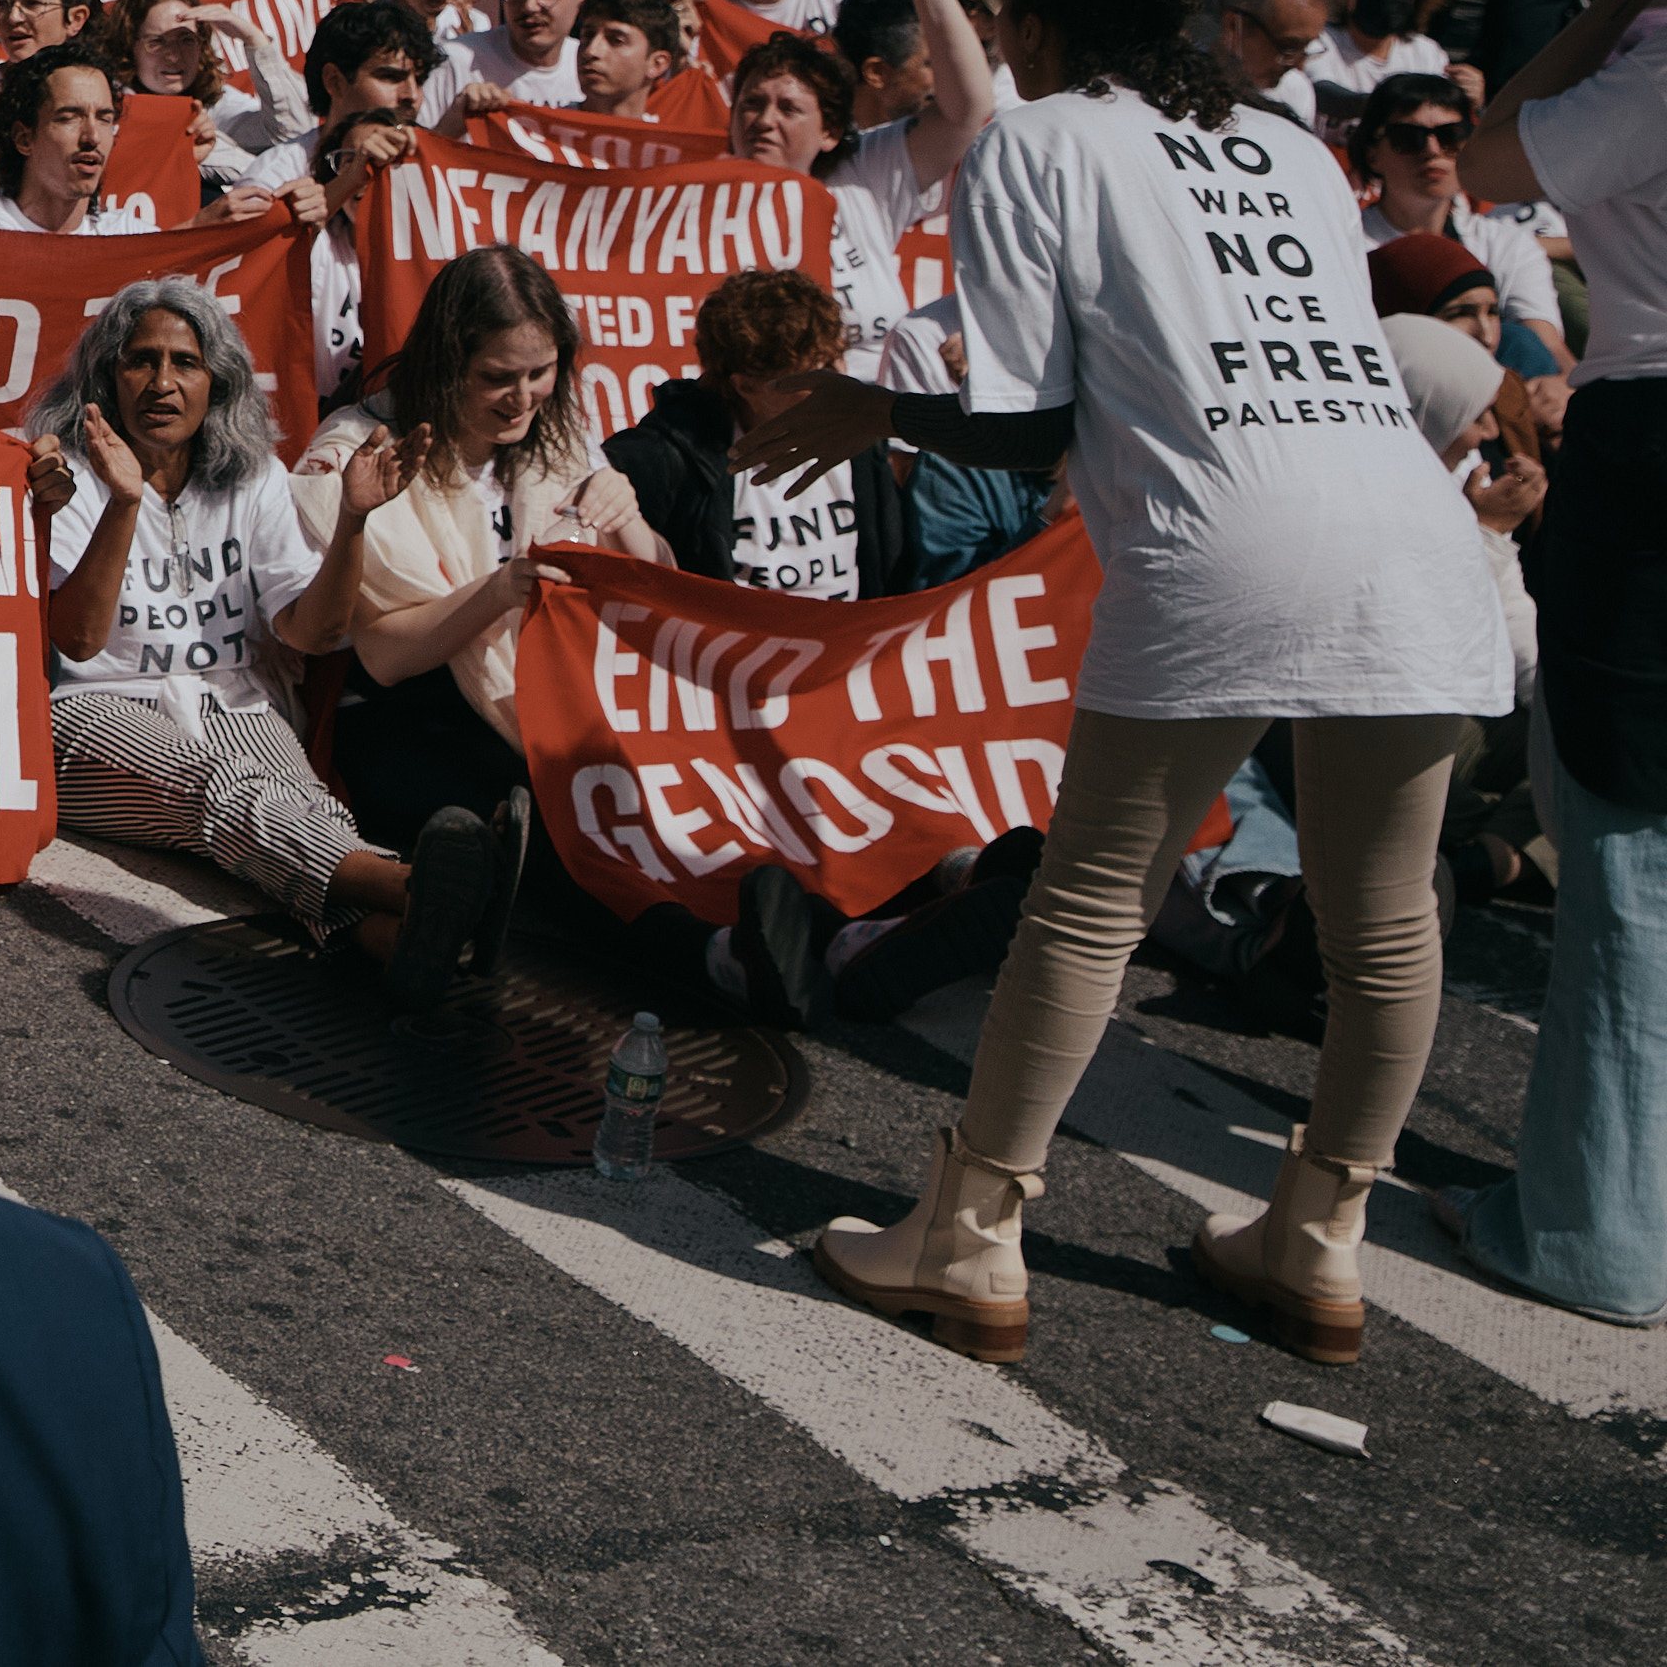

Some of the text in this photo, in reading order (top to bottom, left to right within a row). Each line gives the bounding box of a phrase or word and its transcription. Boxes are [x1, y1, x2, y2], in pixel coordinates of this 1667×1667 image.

[1153, 131, 1273, 176] NO
[389, 161, 804, 275] NETANYAHU
[1188, 187, 1295, 220] WAR
[1204, 231, 1315, 278] NO
[560, 293, 653, 347] TED
[1244, 293, 1327, 324] ICE
[1209, 339, 1391, 387] FREE
[1203, 398, 1412, 433] PALESTIN
[733, 553, 848, 589] EOPL
[119, 593, 244, 631] PEOPL
[138, 629, 246, 674] NOT
[593, 572, 1072, 734] END THE
